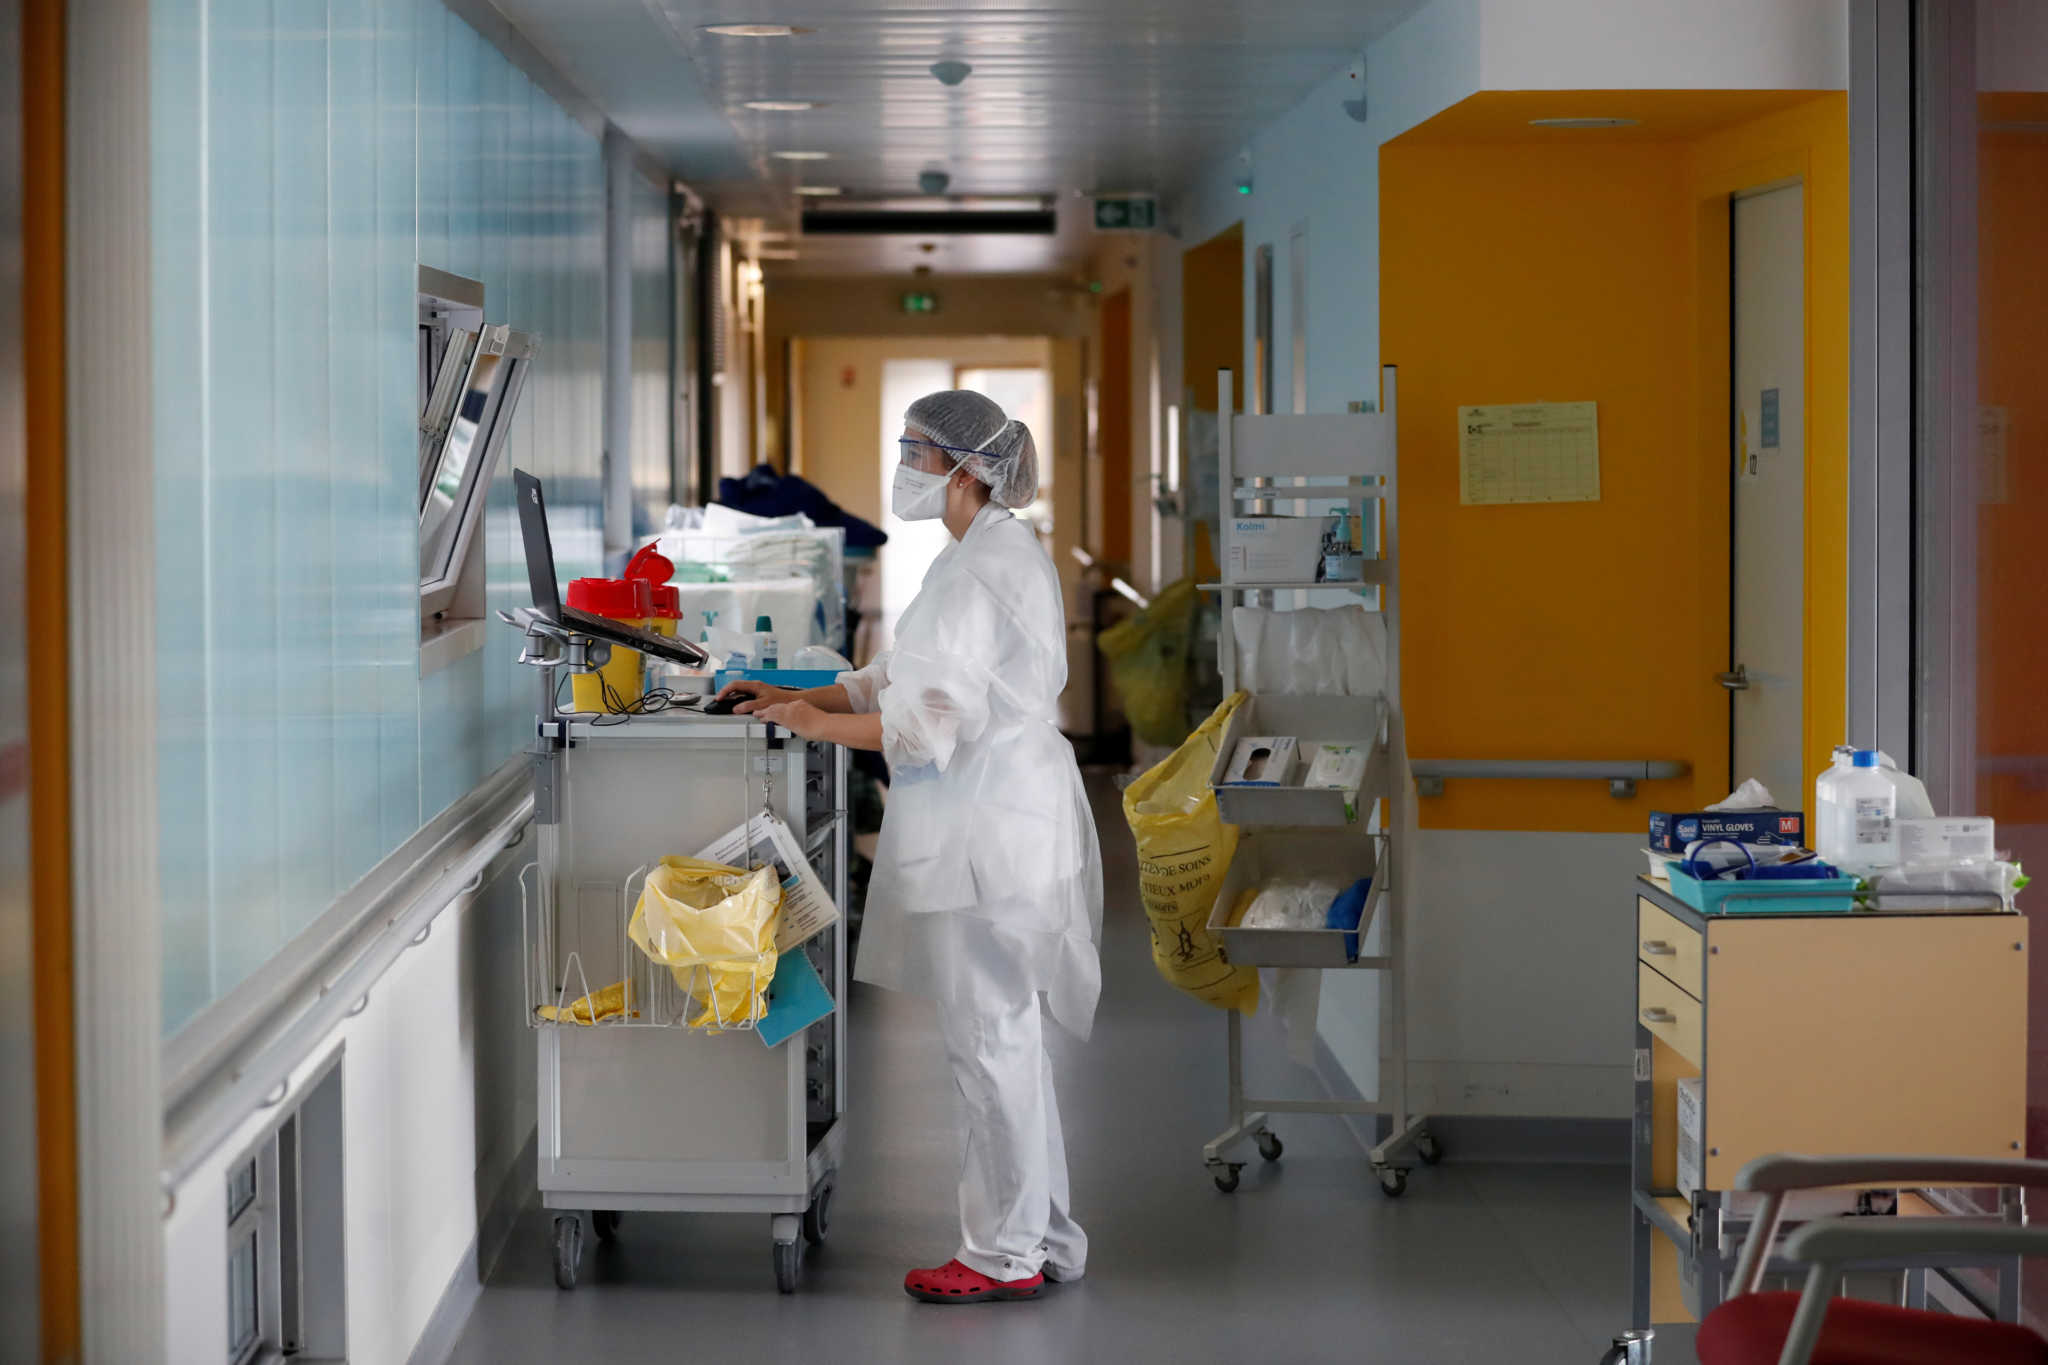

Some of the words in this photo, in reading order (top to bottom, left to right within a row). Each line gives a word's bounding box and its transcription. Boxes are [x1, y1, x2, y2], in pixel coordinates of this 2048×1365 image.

[1236, 522, 1264, 531] Kolmi
[1702, 823, 1724, 832] VINYL
[1725, 823, 1754, 832] GLOVES
[1781, 820, 1793, 831] M
[1178, 855, 1211, 873] SOINS
